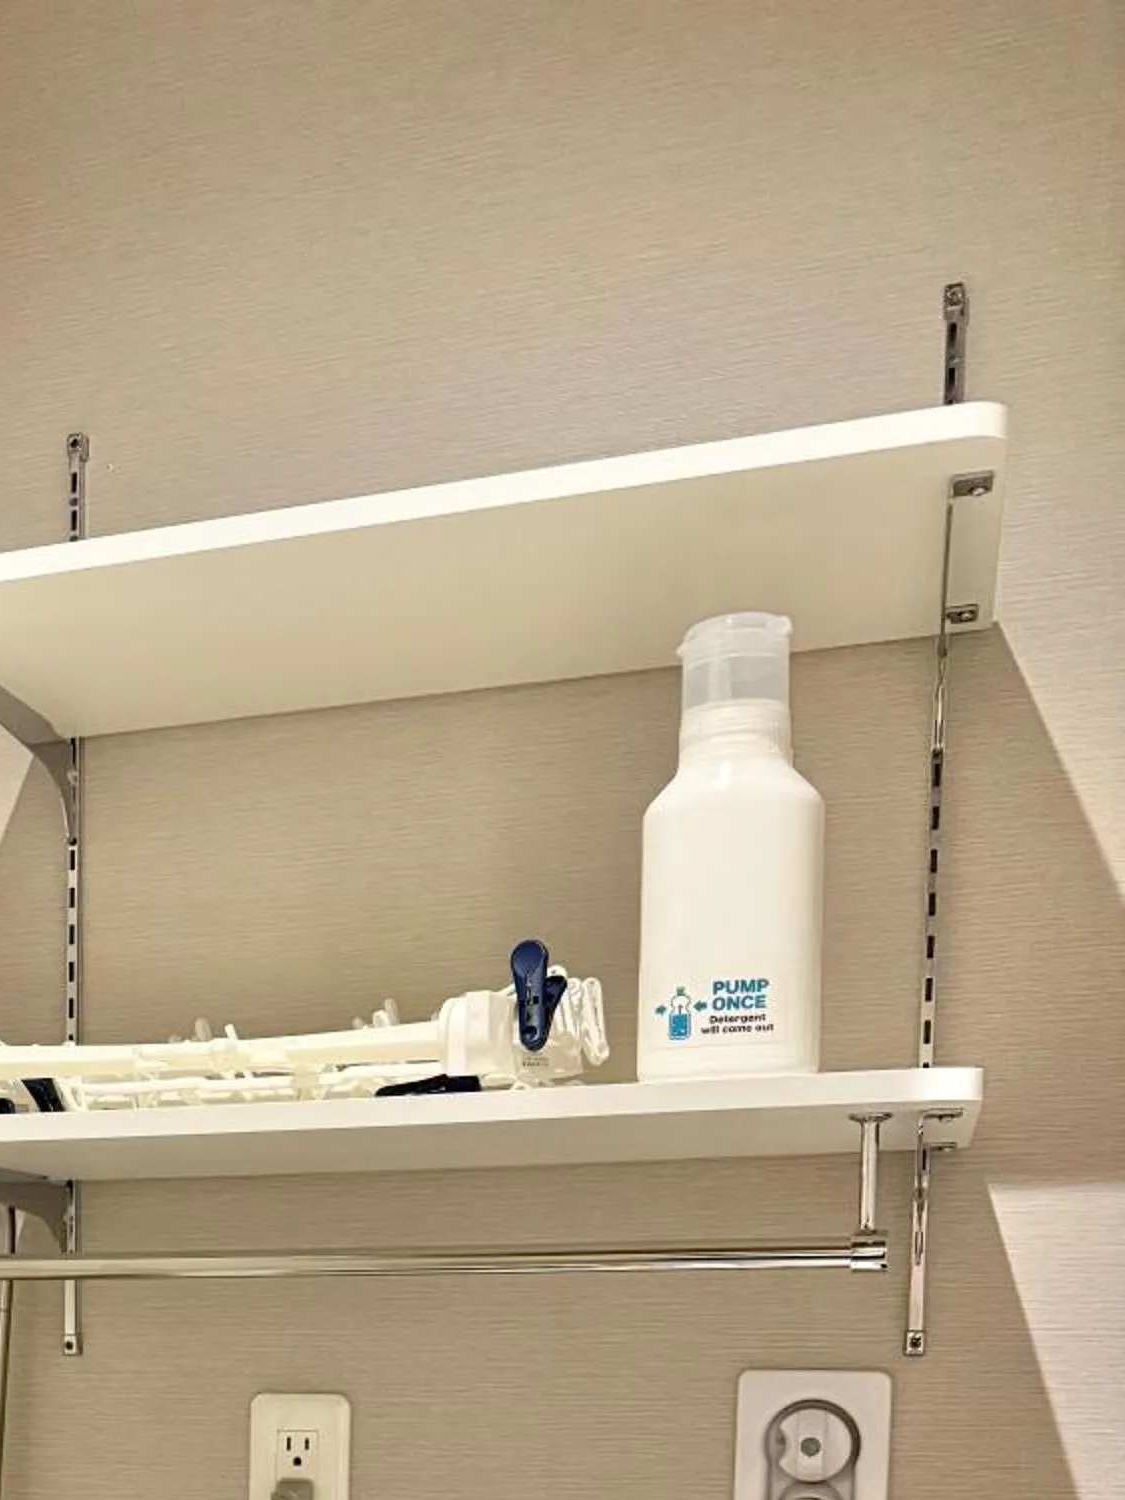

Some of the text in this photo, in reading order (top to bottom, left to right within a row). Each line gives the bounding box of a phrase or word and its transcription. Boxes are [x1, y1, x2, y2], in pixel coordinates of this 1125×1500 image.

[712, 978, 770, 995] PUMP
[712, 995, 766, 1011] ONCE
[709, 1013, 766, 1025] Detergent
[701, 1023, 774, 1035] will come out
